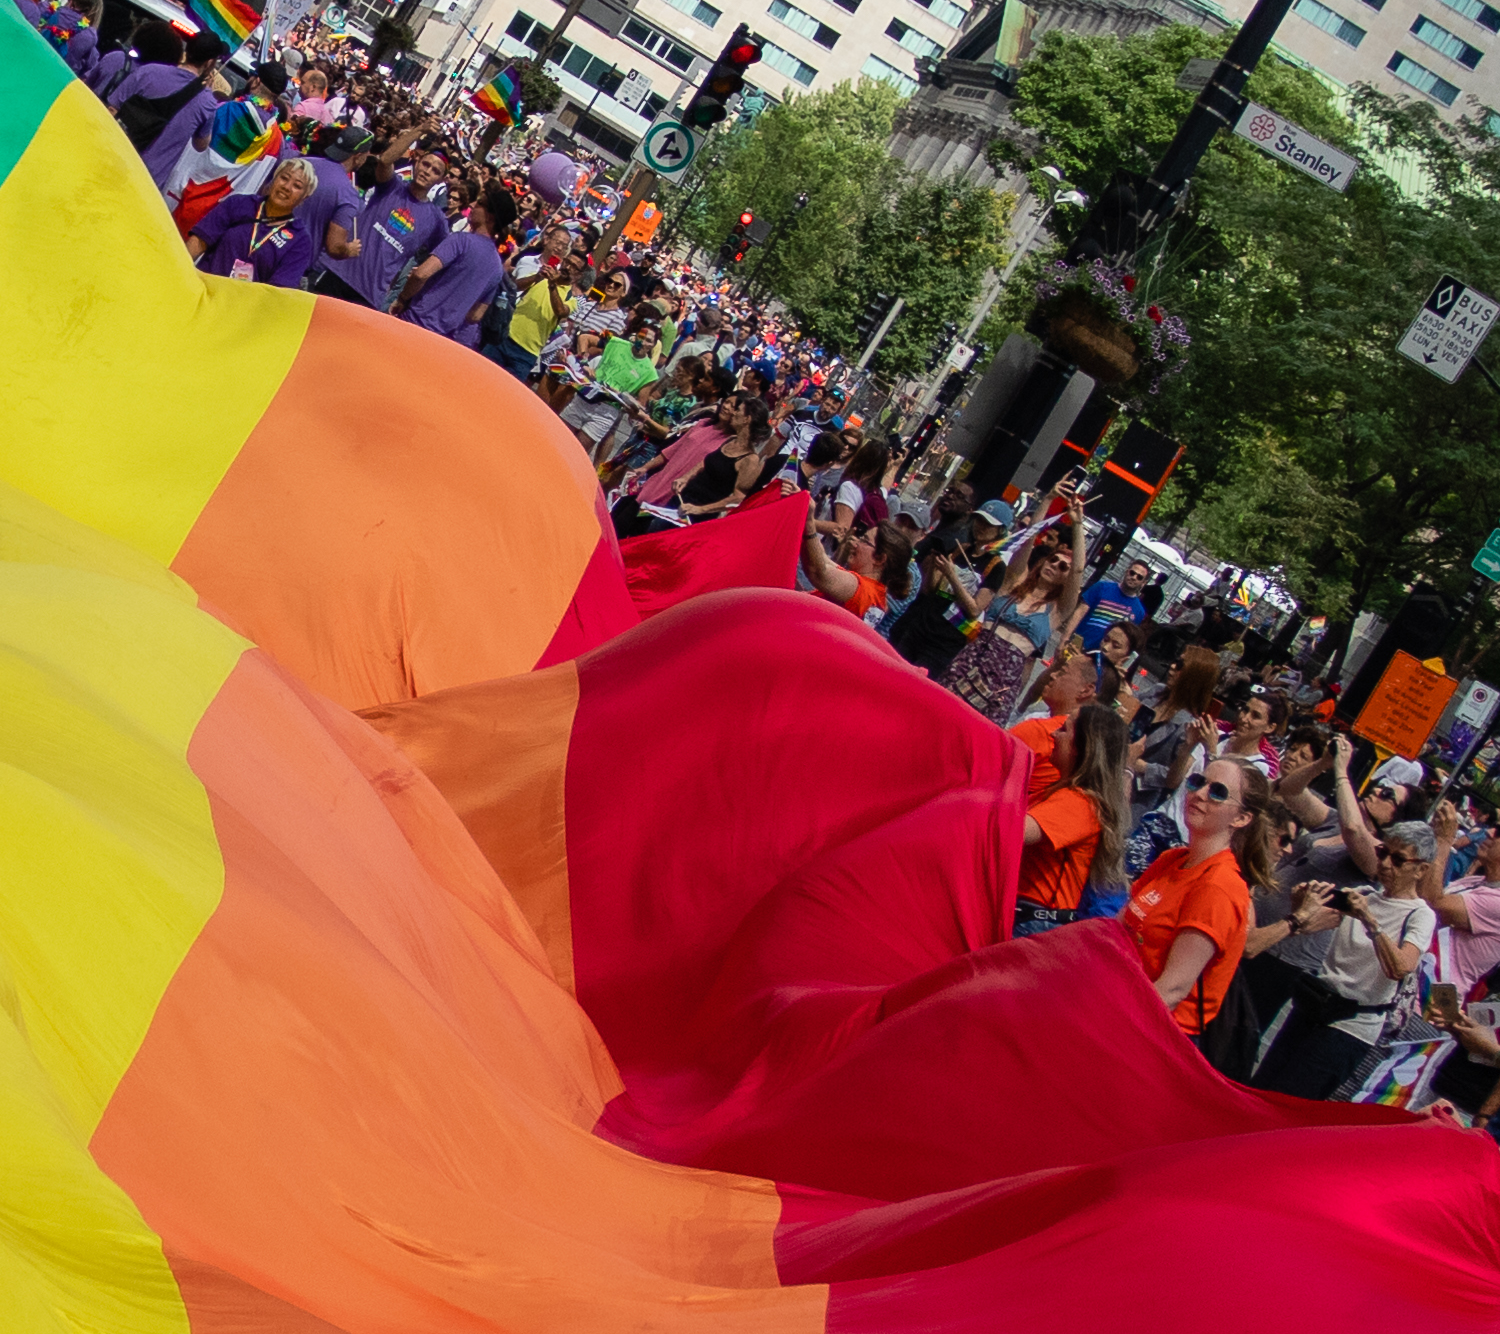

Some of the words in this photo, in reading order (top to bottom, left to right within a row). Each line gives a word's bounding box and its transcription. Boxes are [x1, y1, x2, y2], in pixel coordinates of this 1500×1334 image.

[1283, 124, 1298, 137] Rue
[1275, 134, 1342, 183] Stanley
[1450, 310, 1484, 337] TAXI
[1459, 295, 1492, 321] BUS
[1414, 322, 1439, 340] 15h30
[1445, 340, 1469, 359] 18h30
[1422, 314, 1444, 330] 6h30
[1451, 331, 1473, 348] 9h30
[1413, 333, 1430, 347] LUN
[1441, 350, 1458, 365] VEN
